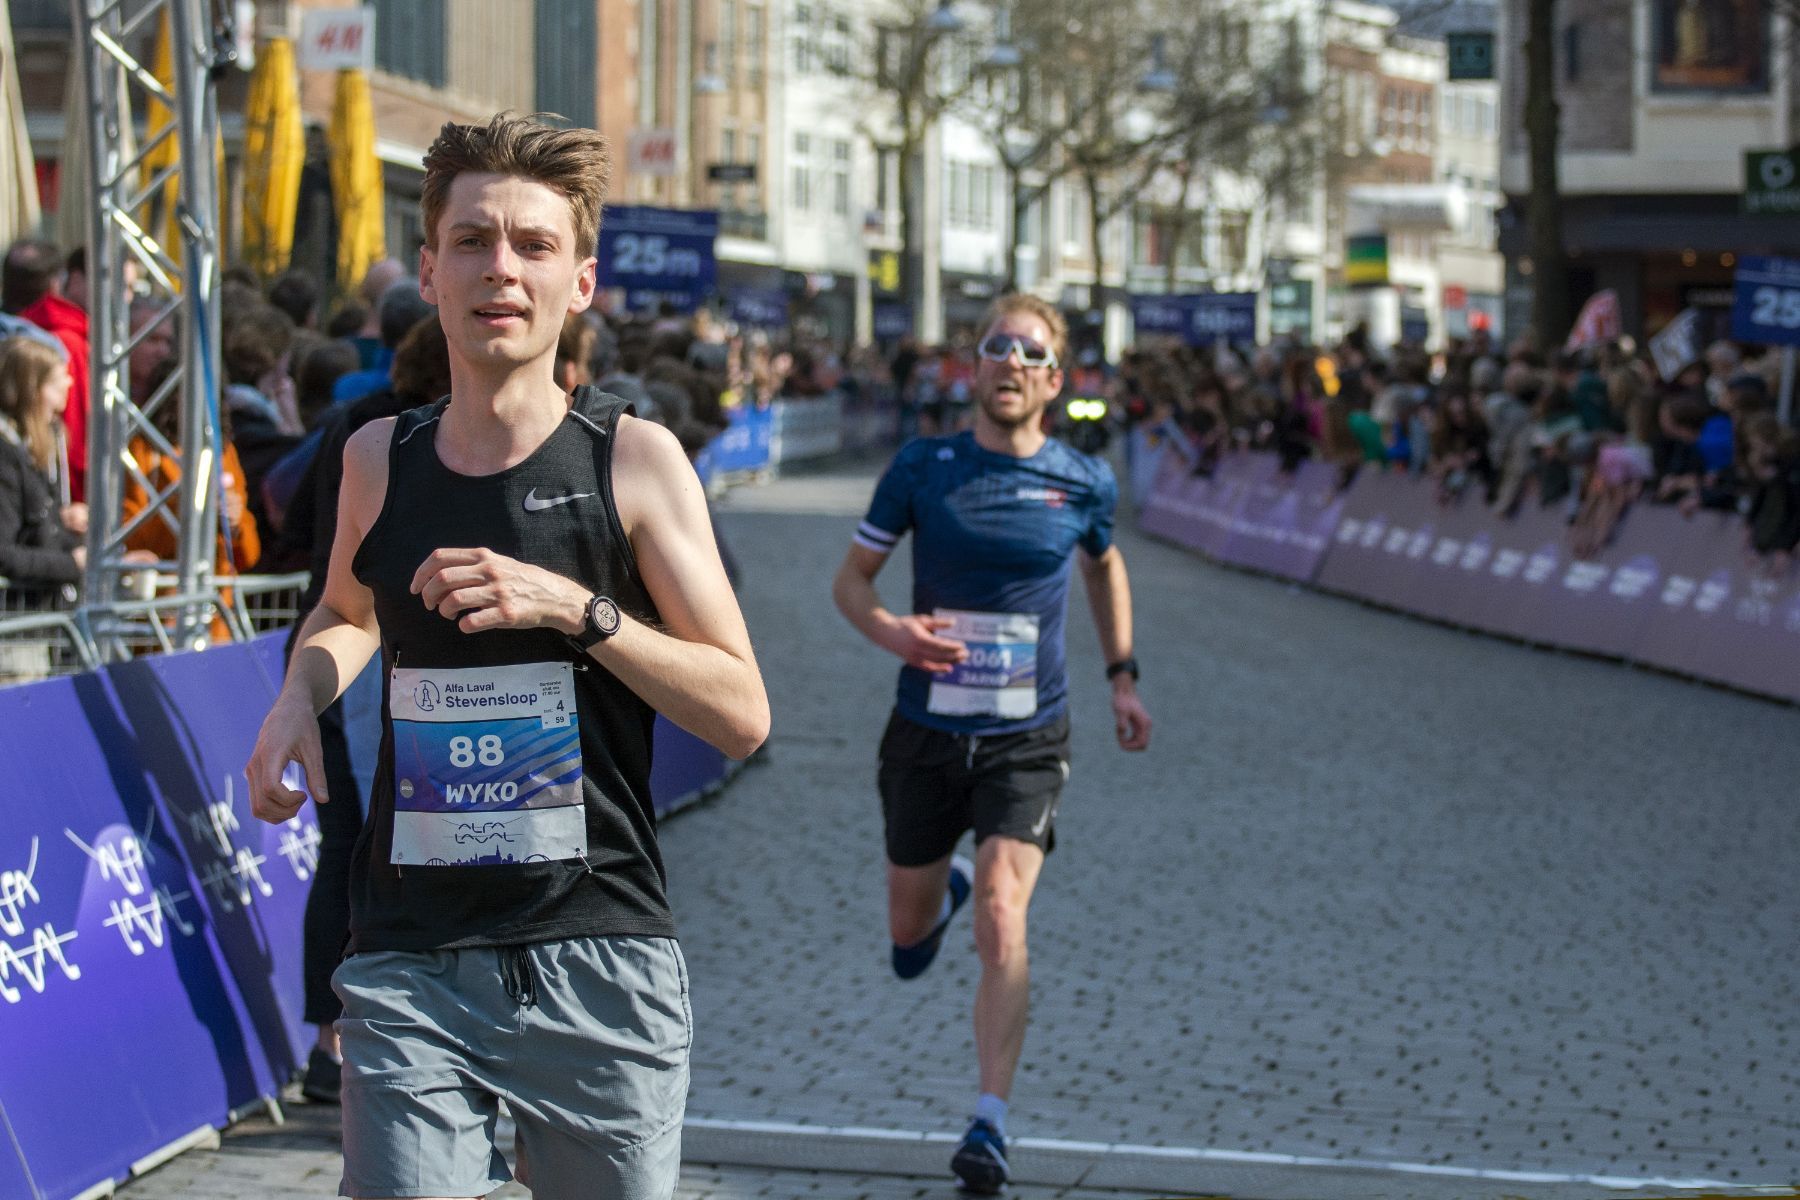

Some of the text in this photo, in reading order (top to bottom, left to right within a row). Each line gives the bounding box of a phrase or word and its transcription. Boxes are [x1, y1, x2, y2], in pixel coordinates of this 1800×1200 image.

[315, 24, 363, 53] HM
[613, 233, 700, 277] 25m
[445, 682, 495, 693] Alfa Laval
[445, 692, 538, 708] Stevensloop
[556, 699, 565, 711] 4
[555, 715, 565, 724] 59
[449, 734, 505, 768] 88
[446, 781, 518, 804] WYKO
[458, 822, 505, 833] ALFA
[455, 832, 515, 844] LAVAL
